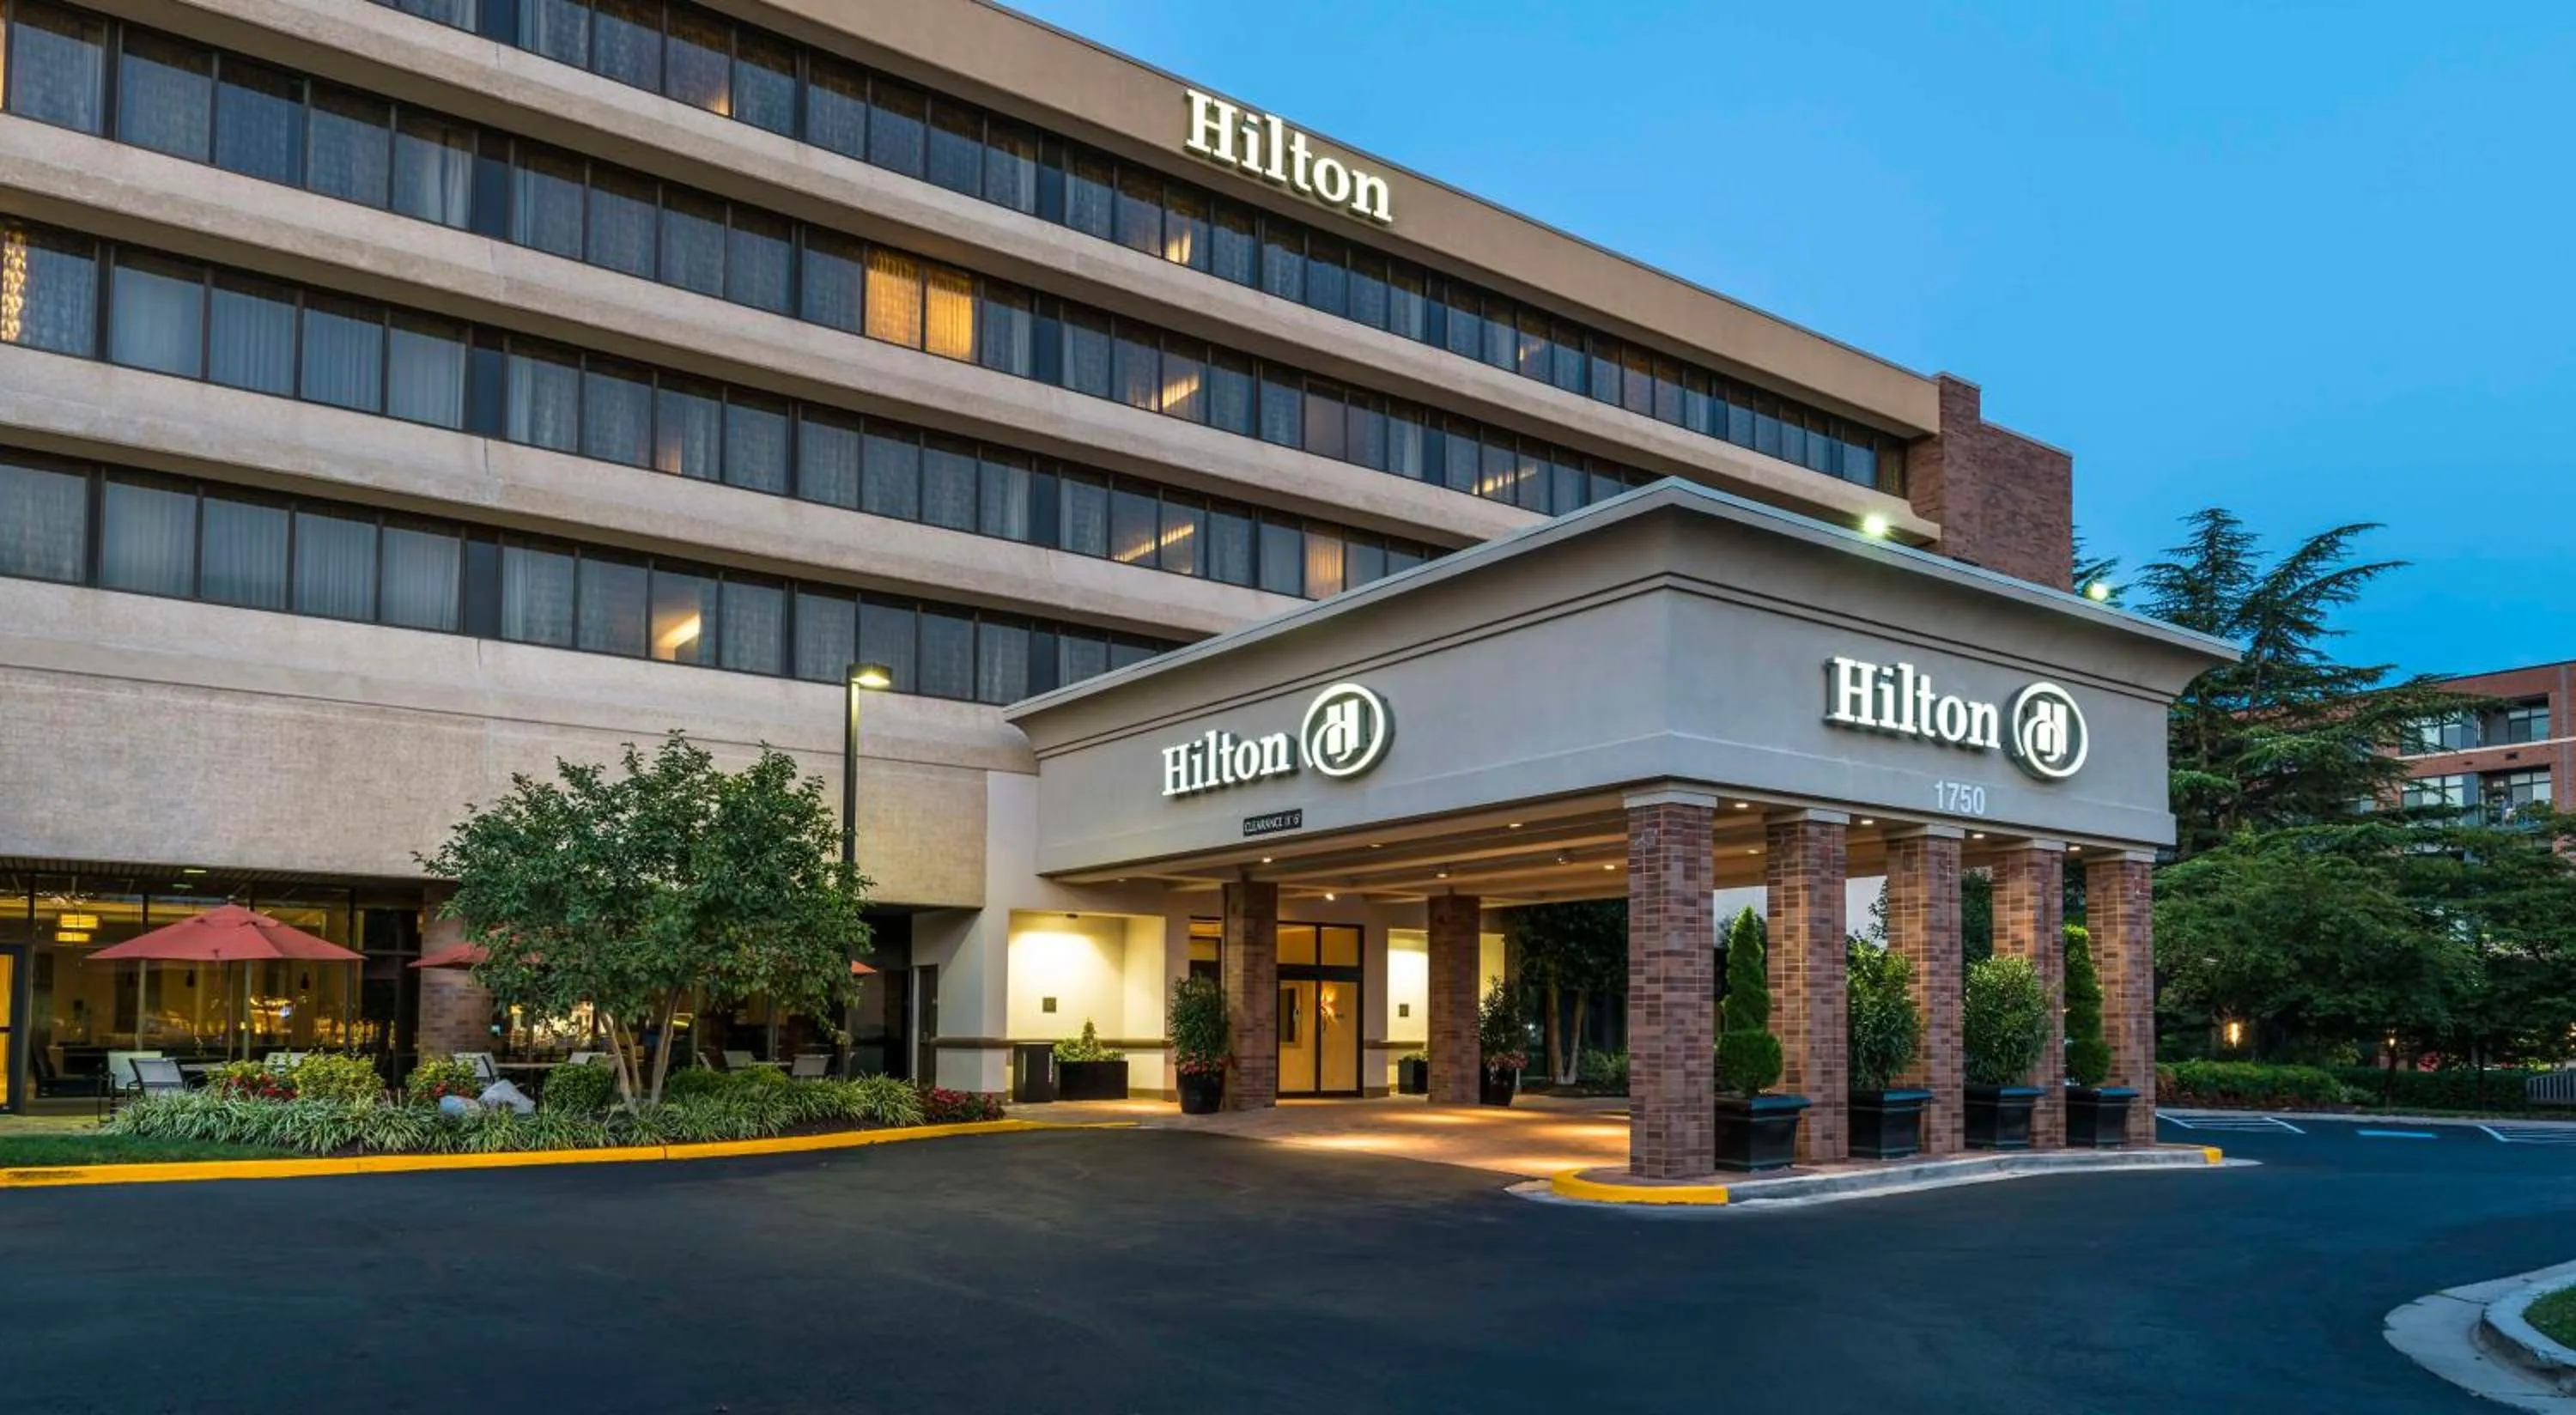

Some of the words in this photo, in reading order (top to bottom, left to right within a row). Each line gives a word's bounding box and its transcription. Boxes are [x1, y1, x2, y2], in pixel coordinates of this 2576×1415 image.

[1186, 88, 1393, 222] Hilton
[1824, 656, 2002, 750] Hilton
[1162, 730, 1291, 796] Hilton
[1934, 780, 1985, 815] 1750
